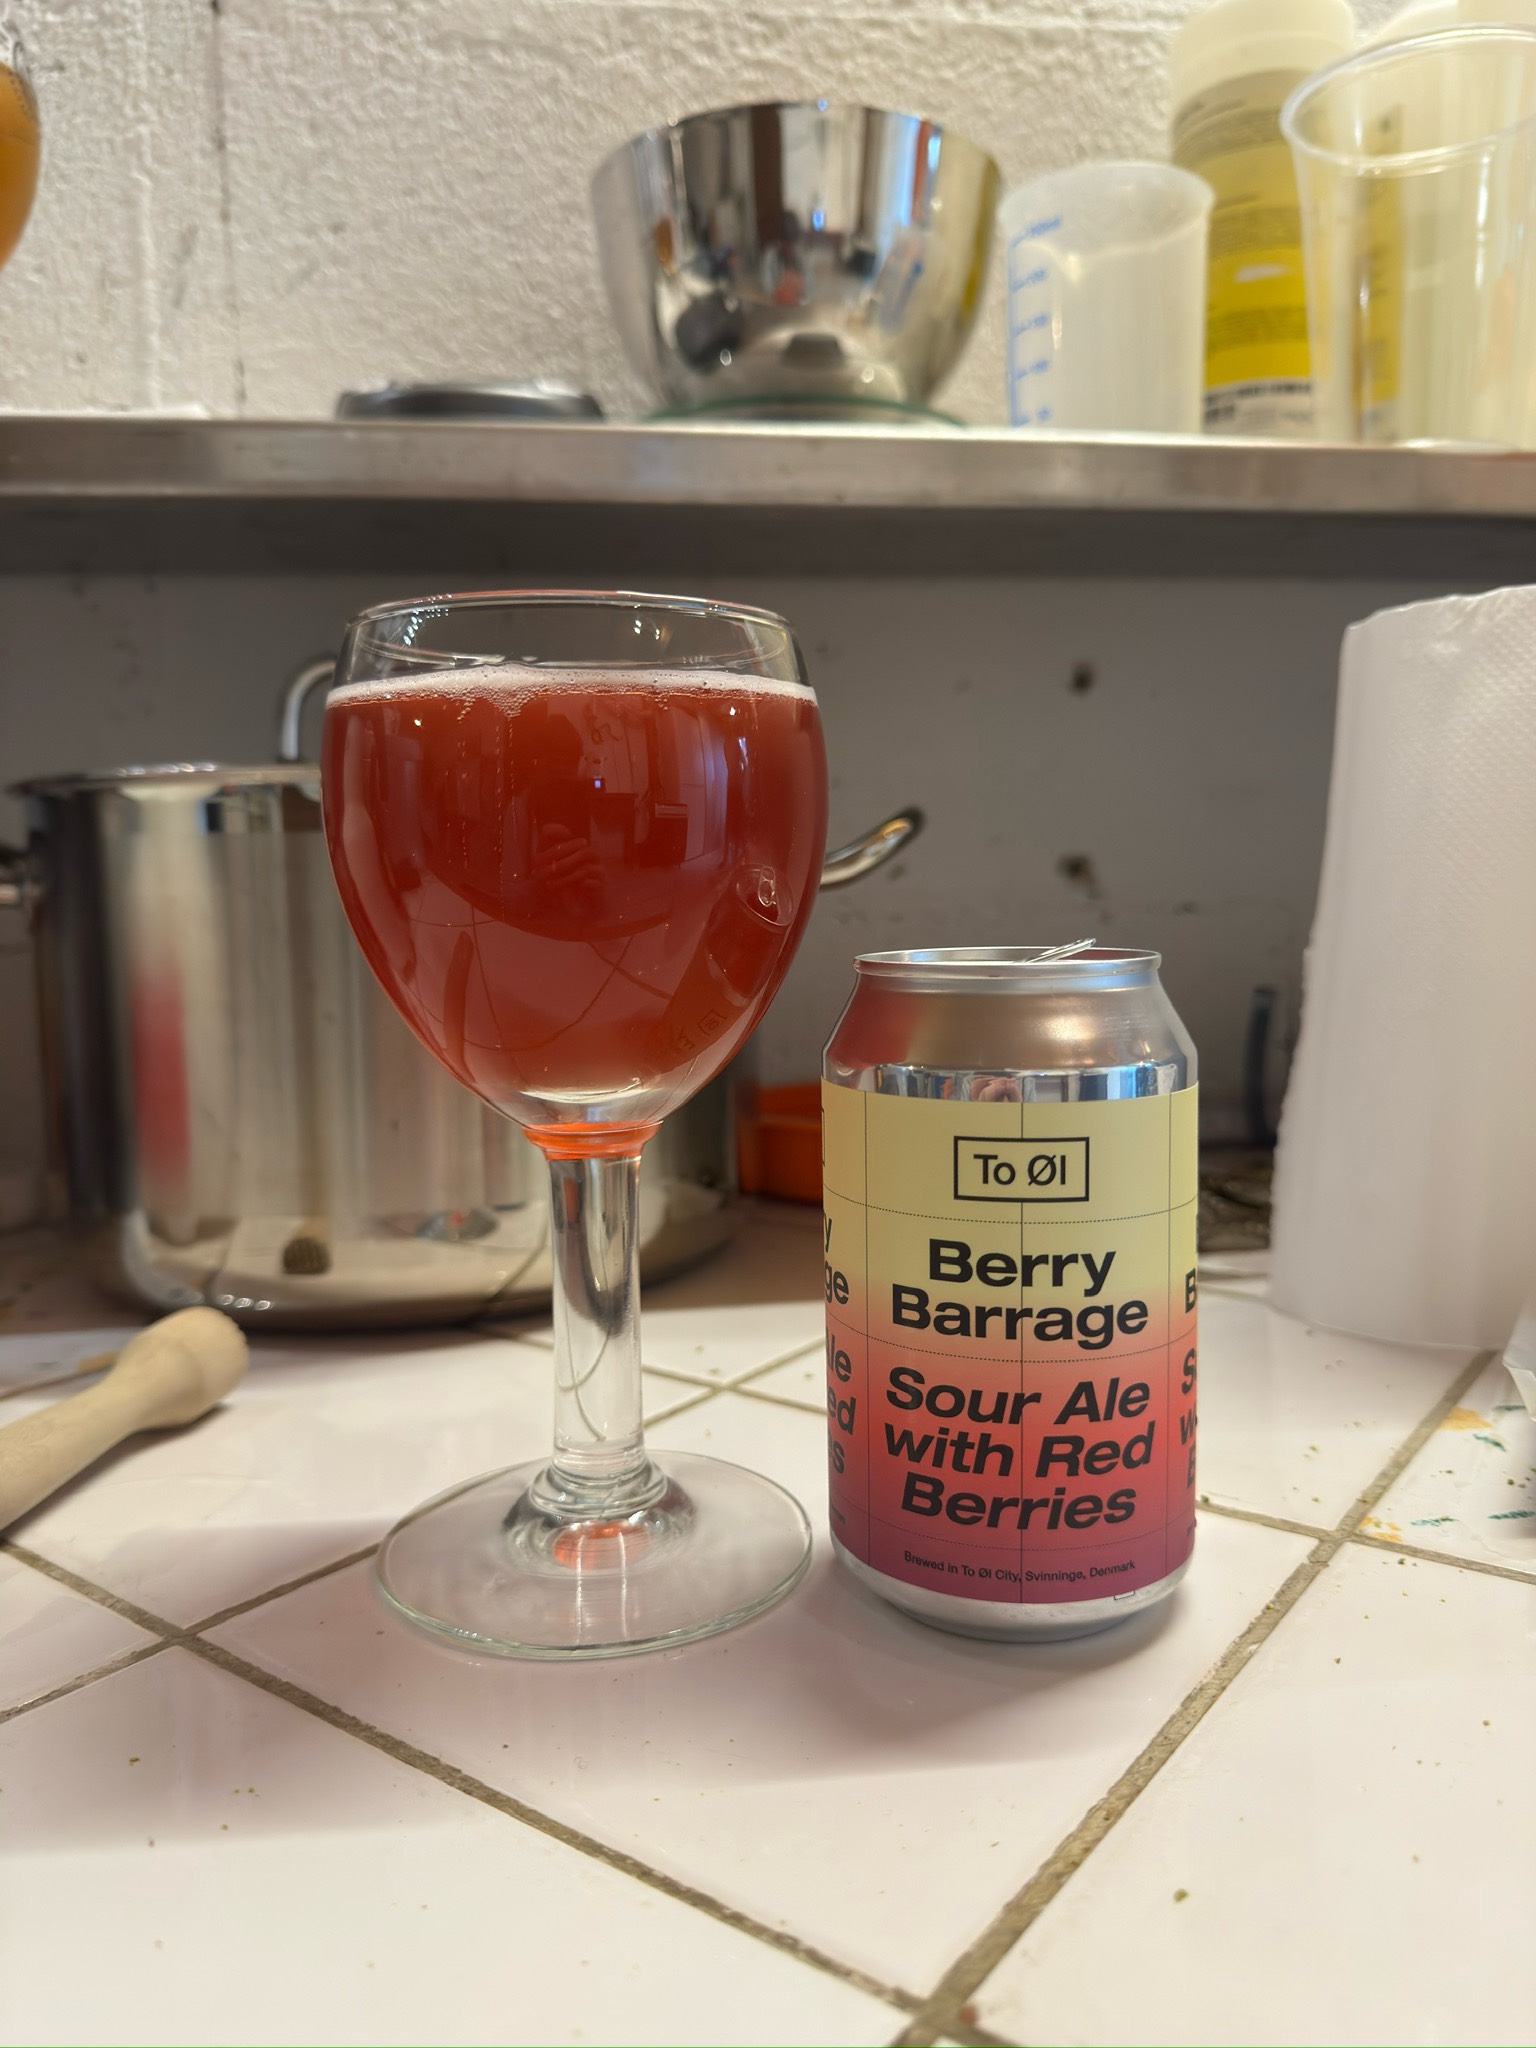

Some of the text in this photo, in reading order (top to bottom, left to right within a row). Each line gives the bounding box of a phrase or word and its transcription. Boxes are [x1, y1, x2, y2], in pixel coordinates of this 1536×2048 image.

[972, 1154, 1066, 1186] To Øl
[929, 1238, 1116, 1297] Berry
[892, 1283, 1148, 1350] Barrage
[826, 1333, 852, 1382] le
[828, 1386, 856, 1435] ed
[886, 1366, 1150, 1425] Sour Ale
[884, 1422, 1014, 1477] with
[1035, 1420, 1155, 1478] Red
[901, 1471, 1136, 1530] Berries
[904, 1551, 1136, 1583] Brewed in To Øl City, Svinninge, Denmark
